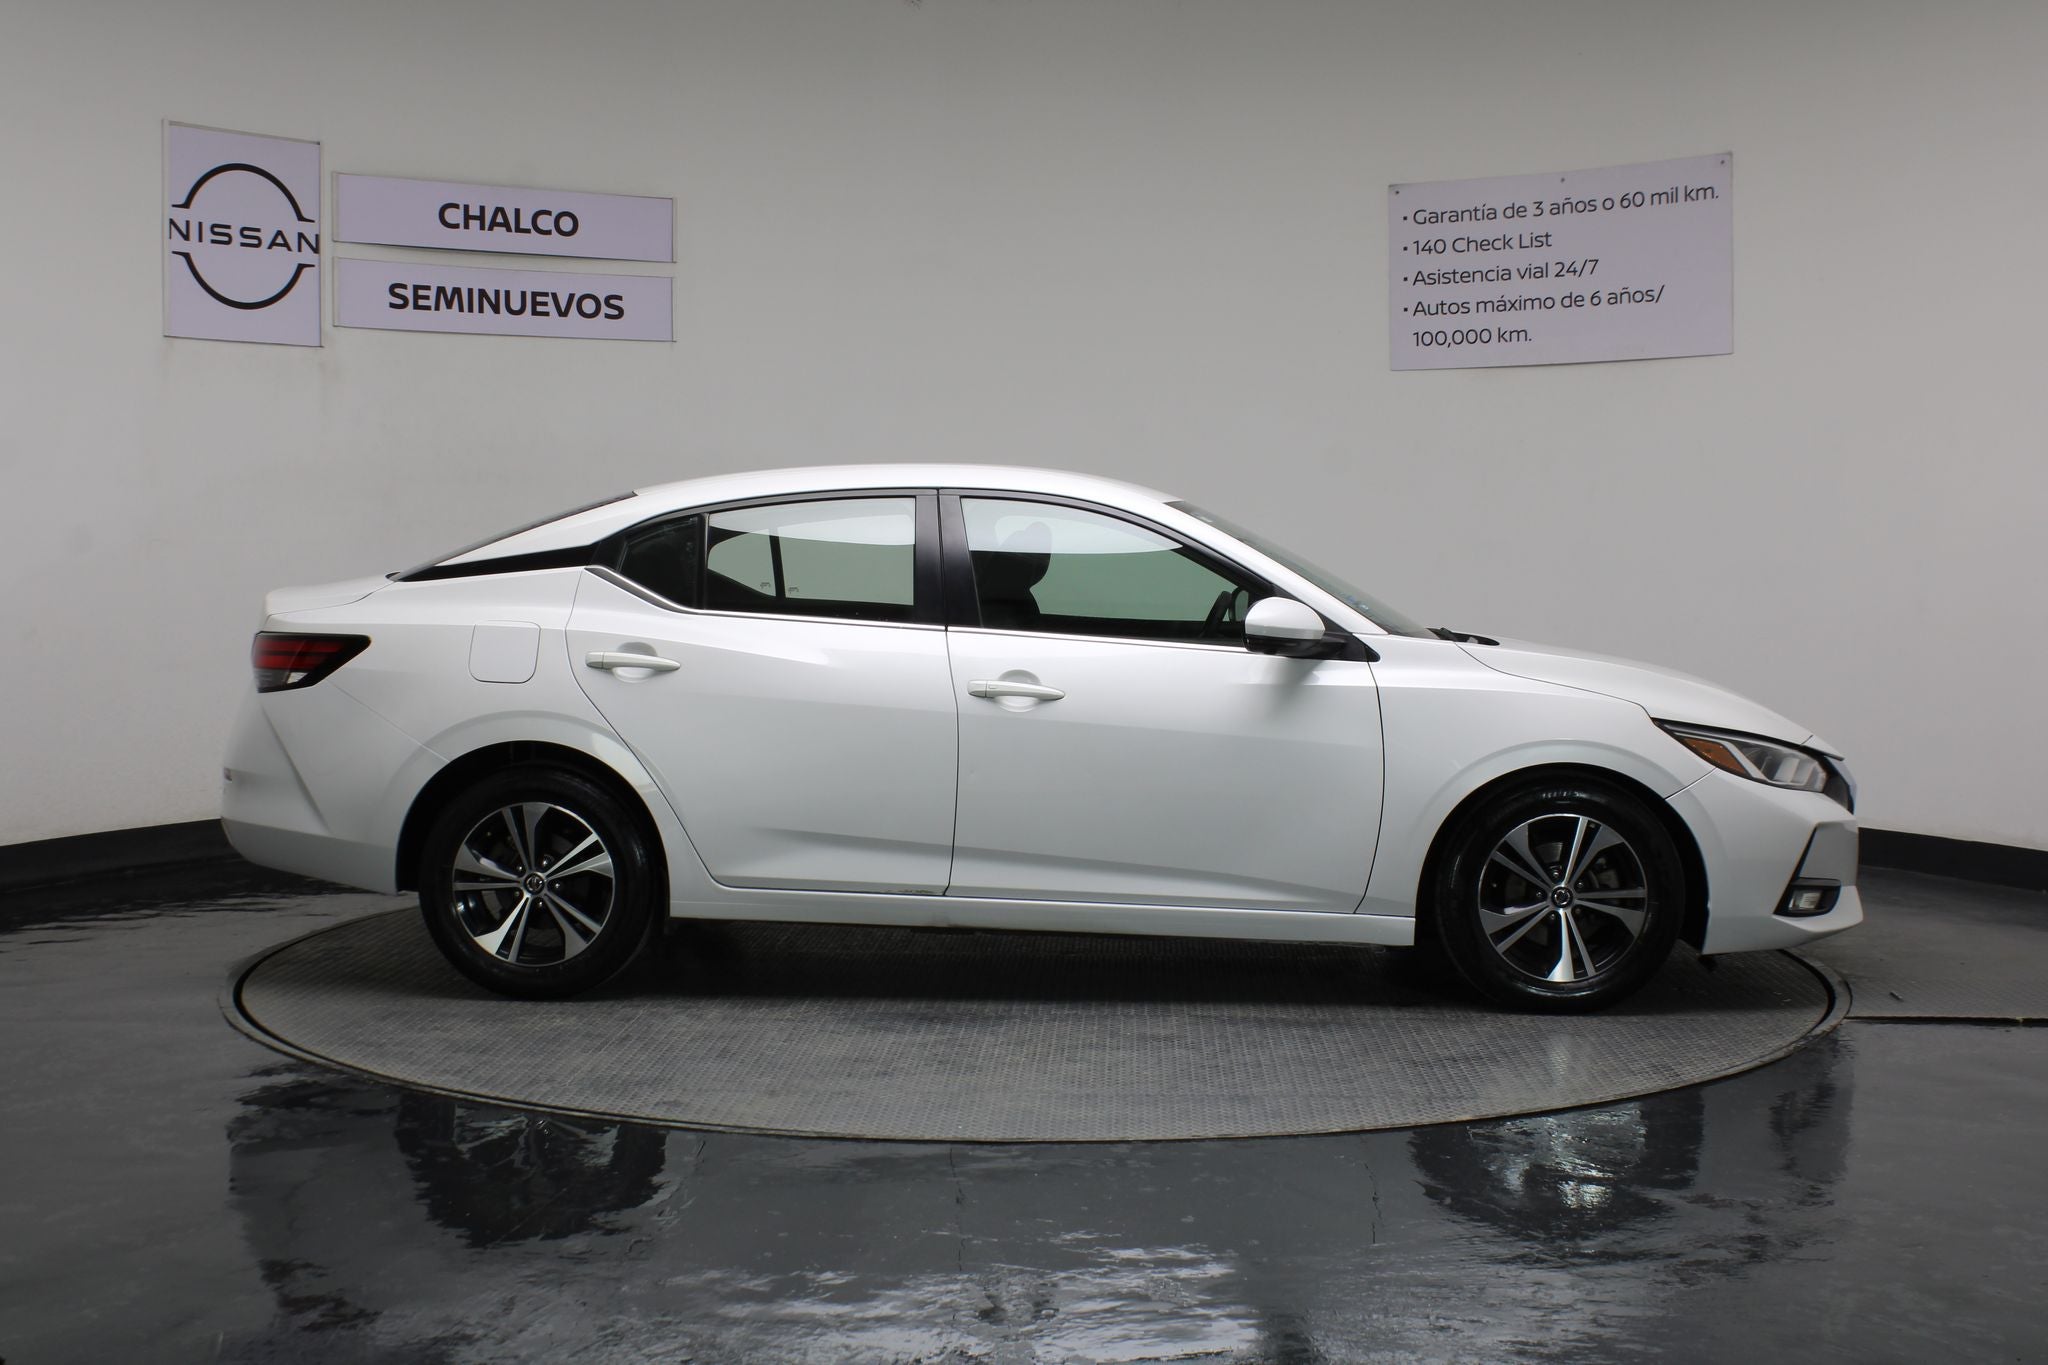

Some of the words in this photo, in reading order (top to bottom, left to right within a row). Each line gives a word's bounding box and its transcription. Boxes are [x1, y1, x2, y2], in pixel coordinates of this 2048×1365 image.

[438, 202, 579, 238] CHALCO
[1412, 203, 1498, 225] Garantía
[1502, 202, 1528, 220] de
[1532, 200, 1544, 217] 3
[1549, 197, 1598, 216] años
[1602, 197, 1615, 211] o
[1619, 191, 1645, 209] 60
[1650, 186, 1679, 206] mil
[1684, 185, 1719, 203] km.
[169, 218, 320, 255] NISSAN
[1412, 238, 1447, 256] 140
[1451, 233, 1514, 254] Check
[1519, 231, 1553, 249] List
[1412, 265, 1512, 287] Asistencia
[1516, 261, 1549, 280] vial
[1554, 258, 1600, 278] 24/7
[388, 282, 625, 321] SEMINUEVOS
[1412, 300, 1471, 317] Autos
[1476, 294, 1556, 314] máximo
[1560, 291, 1585, 309] de
[1590, 290, 1602, 307] 6
[1607, 284, 1665, 306] años/
[1412, 328, 1492, 349] 100,000
[1497, 326, 1532, 344] km.
